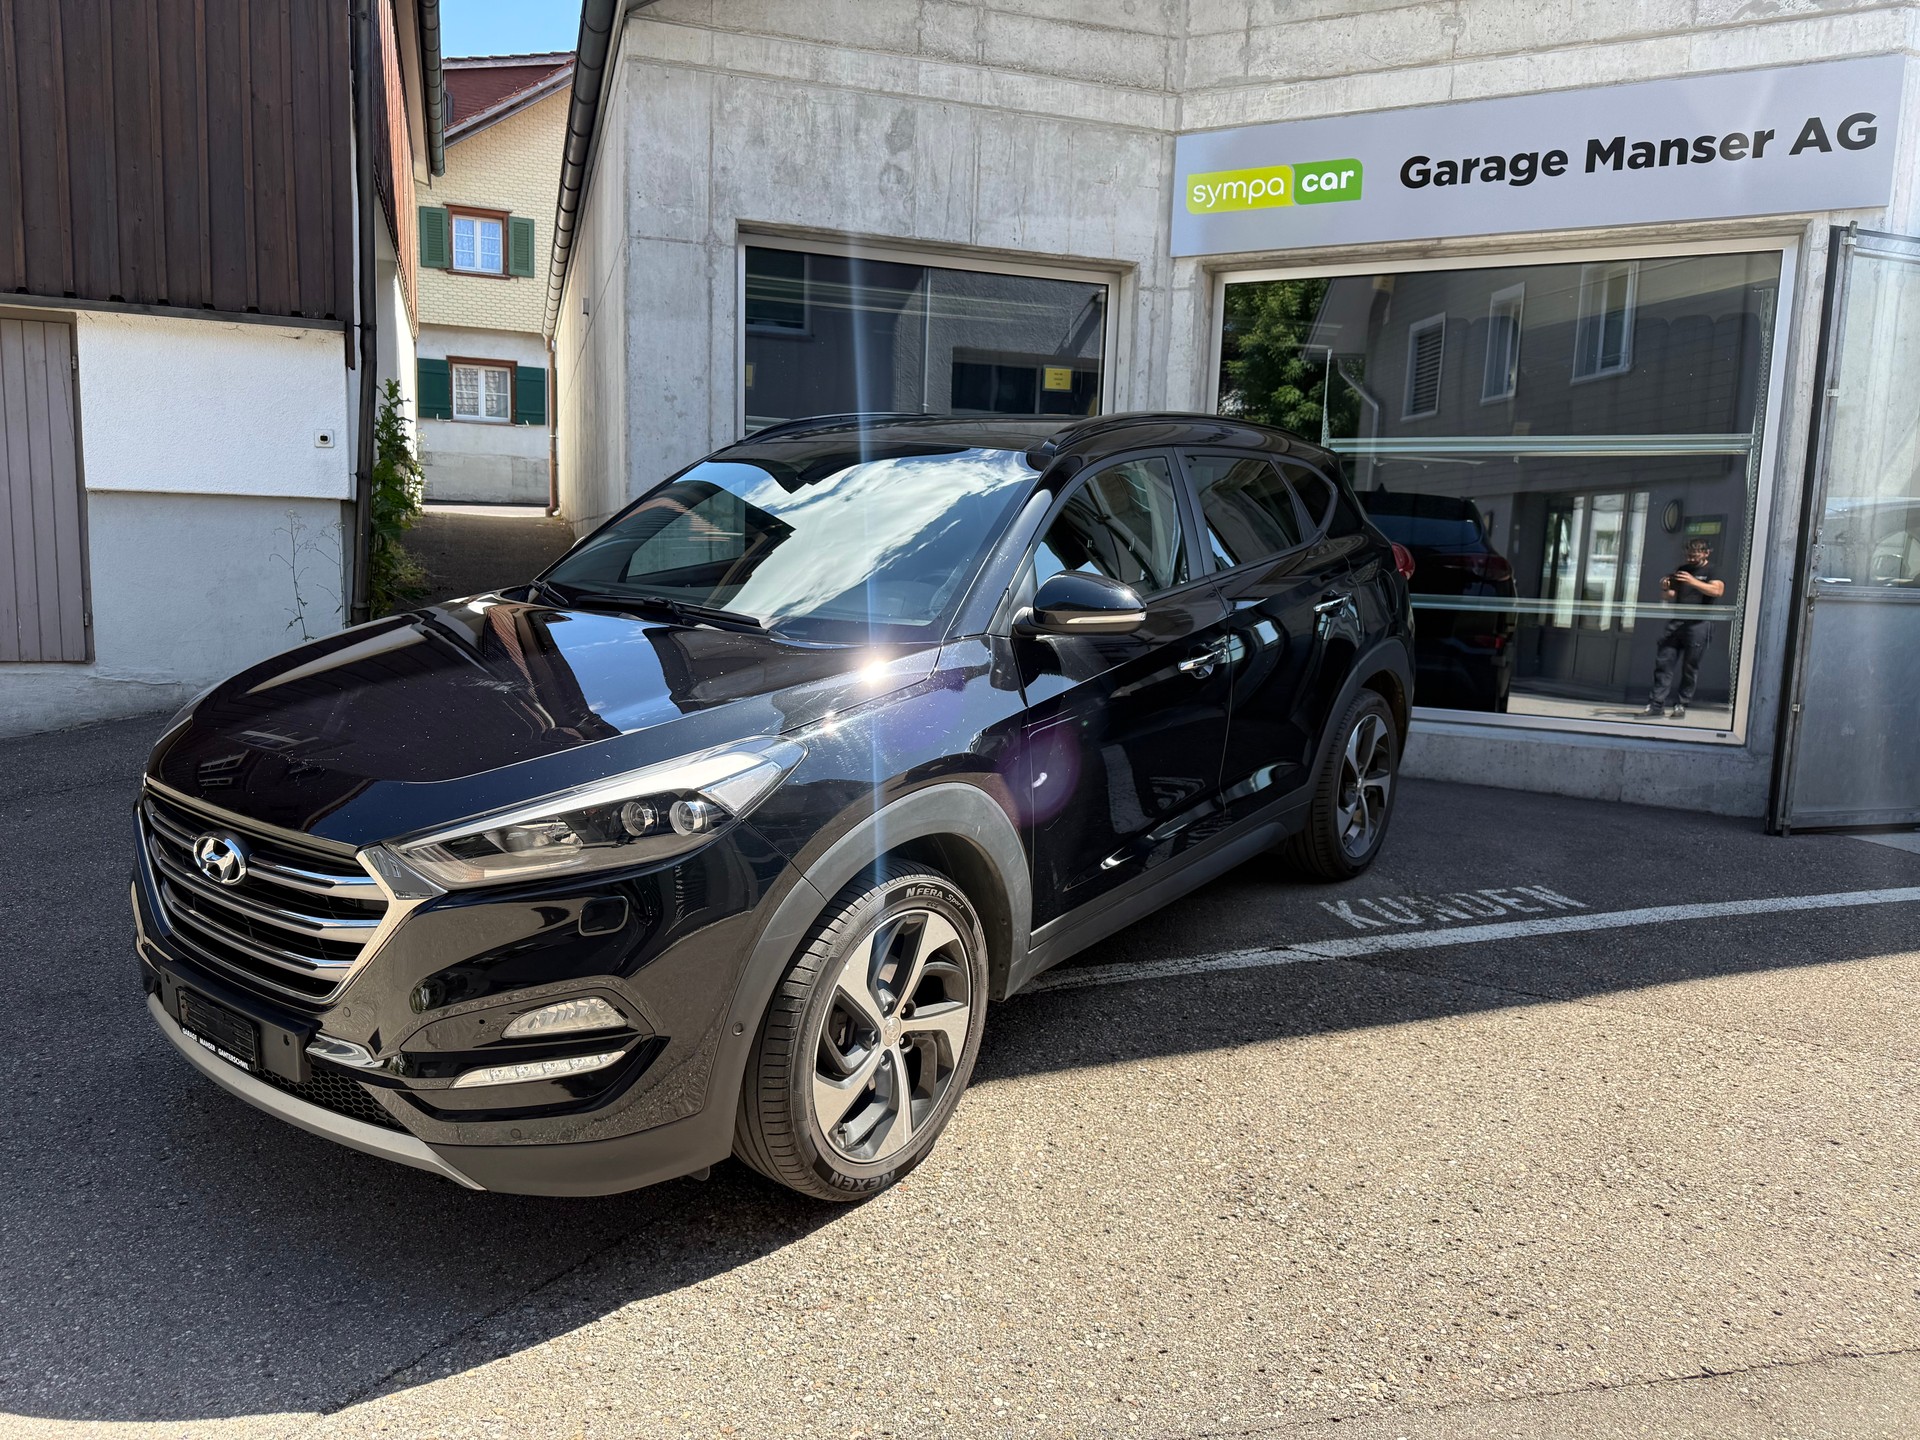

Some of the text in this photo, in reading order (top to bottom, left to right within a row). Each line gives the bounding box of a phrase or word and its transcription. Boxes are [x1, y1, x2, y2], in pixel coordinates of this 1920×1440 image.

[1399, 112, 1878, 190] Garage Manser AG
[1193, 169, 1355, 208] sympa car
[1317, 884, 1590, 930] KUNDEN
[182, 1027, 198, 1042] GARAGE
[199, 1037, 216, 1052] MANSER
[829, 1169, 896, 1191] NEXEN
